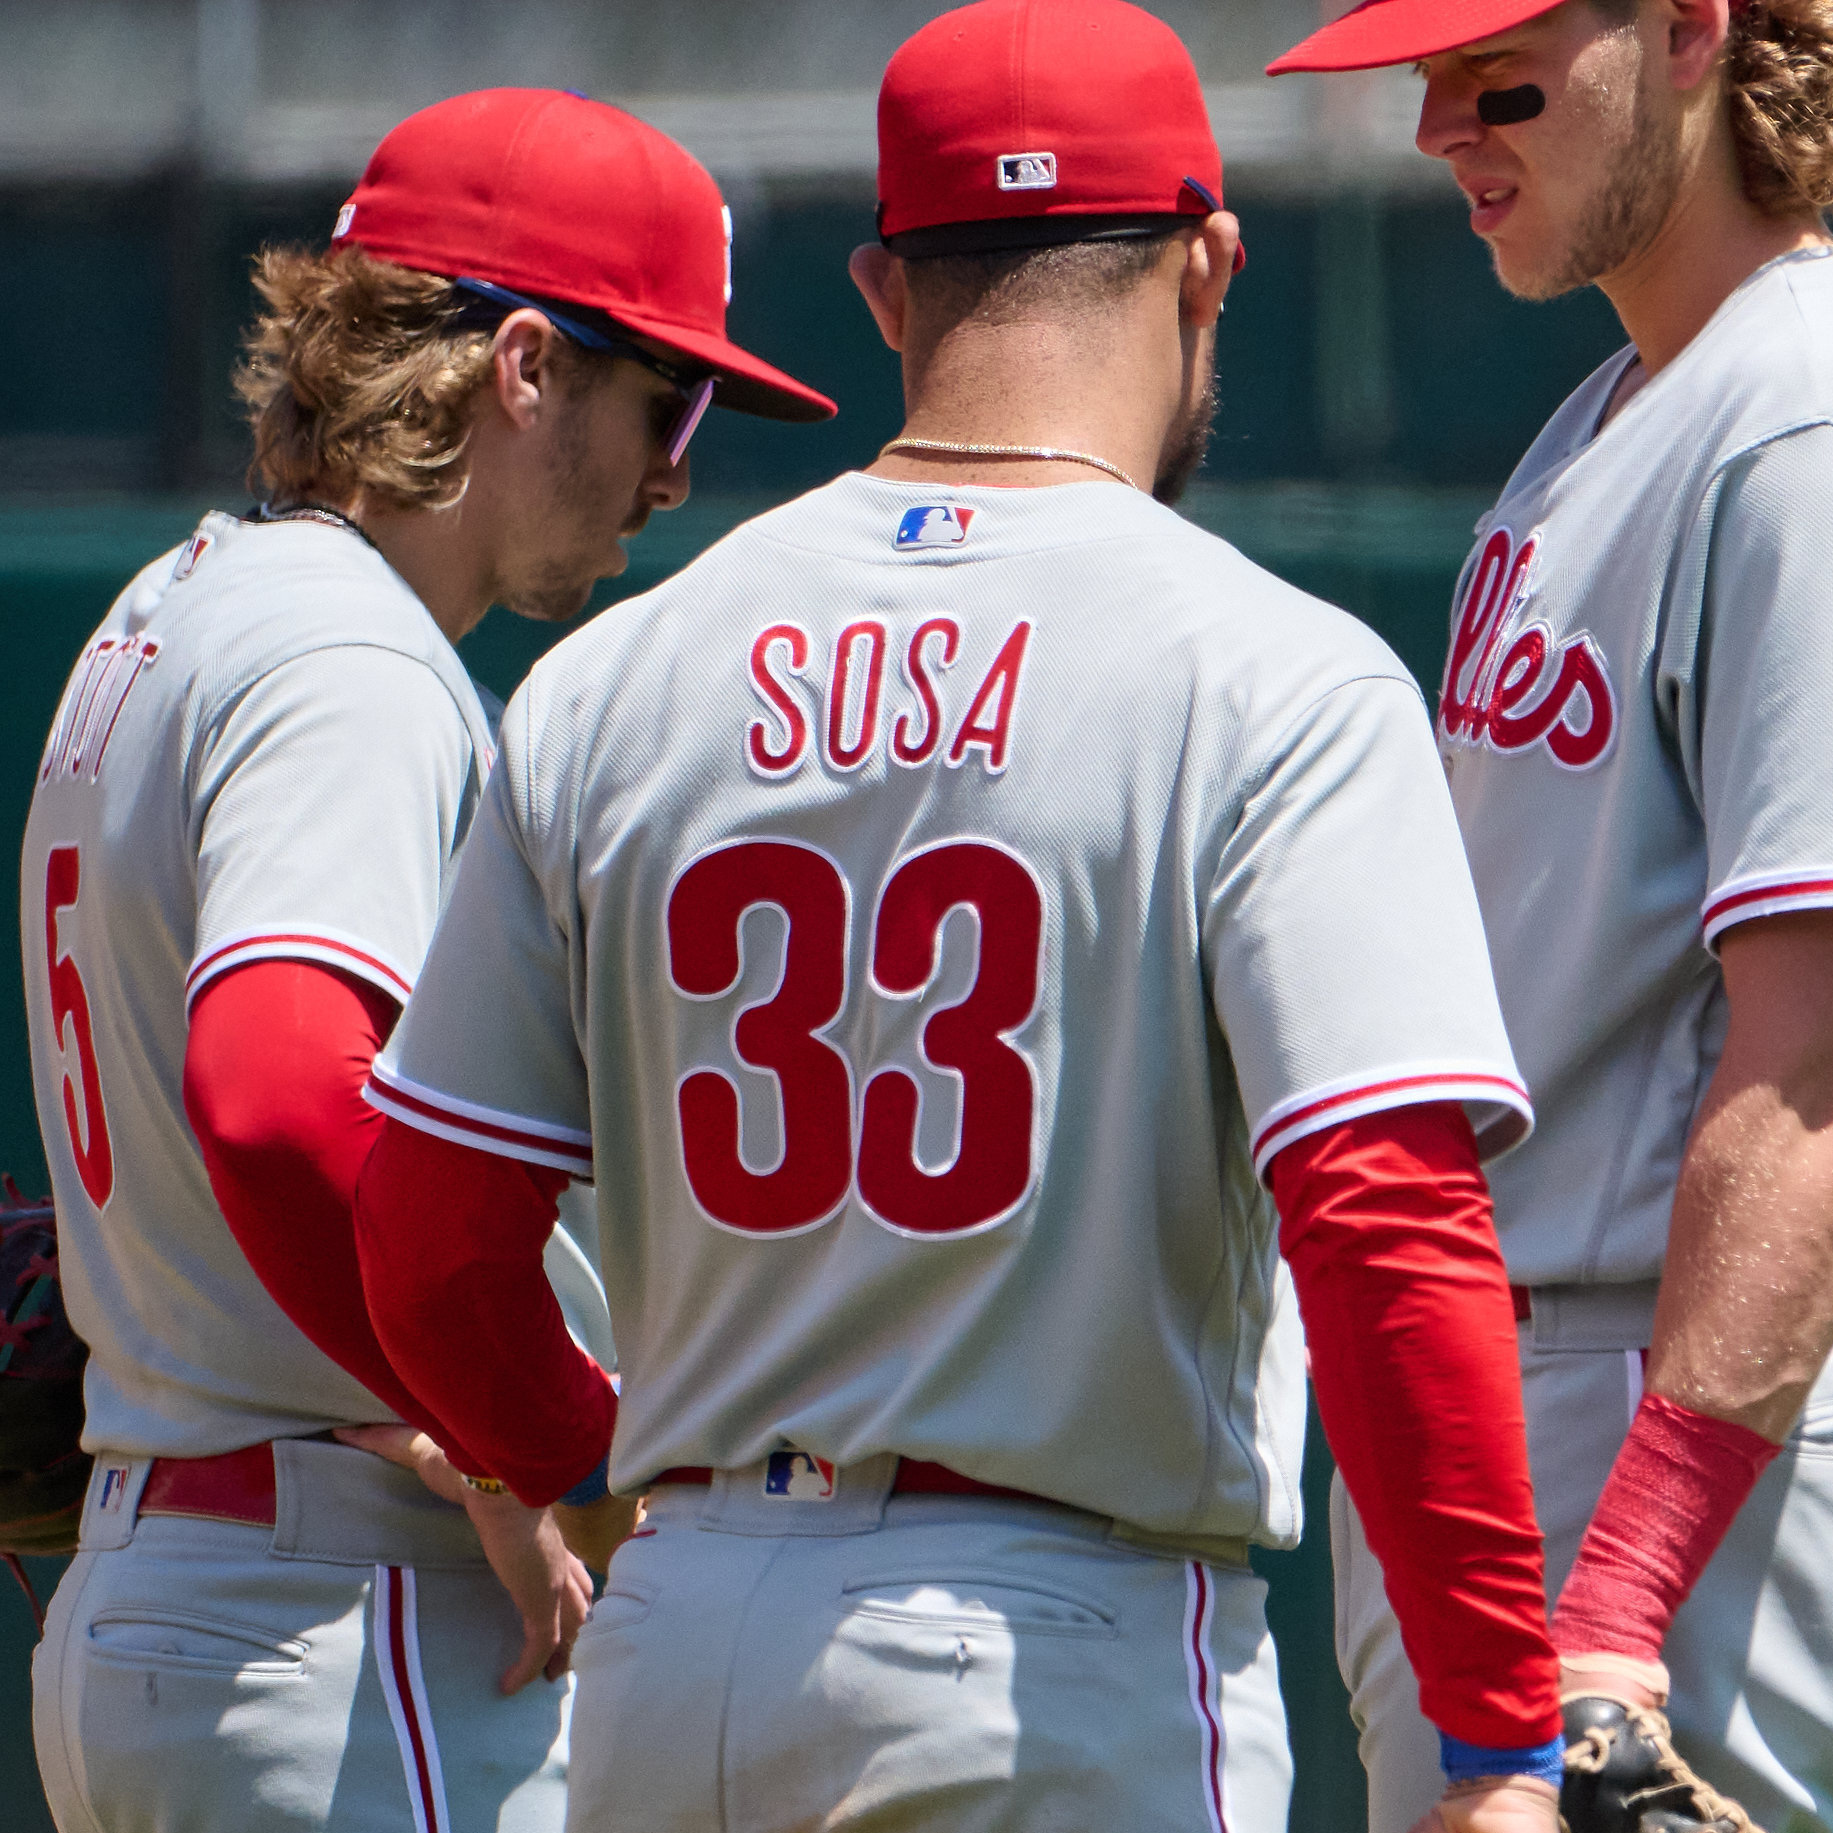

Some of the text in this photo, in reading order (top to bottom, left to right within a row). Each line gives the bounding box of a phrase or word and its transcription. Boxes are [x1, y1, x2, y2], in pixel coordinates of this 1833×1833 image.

[745, 611, 1038, 781] SOSA
[45, 841, 115, 1217] 5
[663, 836, 1049, 1241] 33
